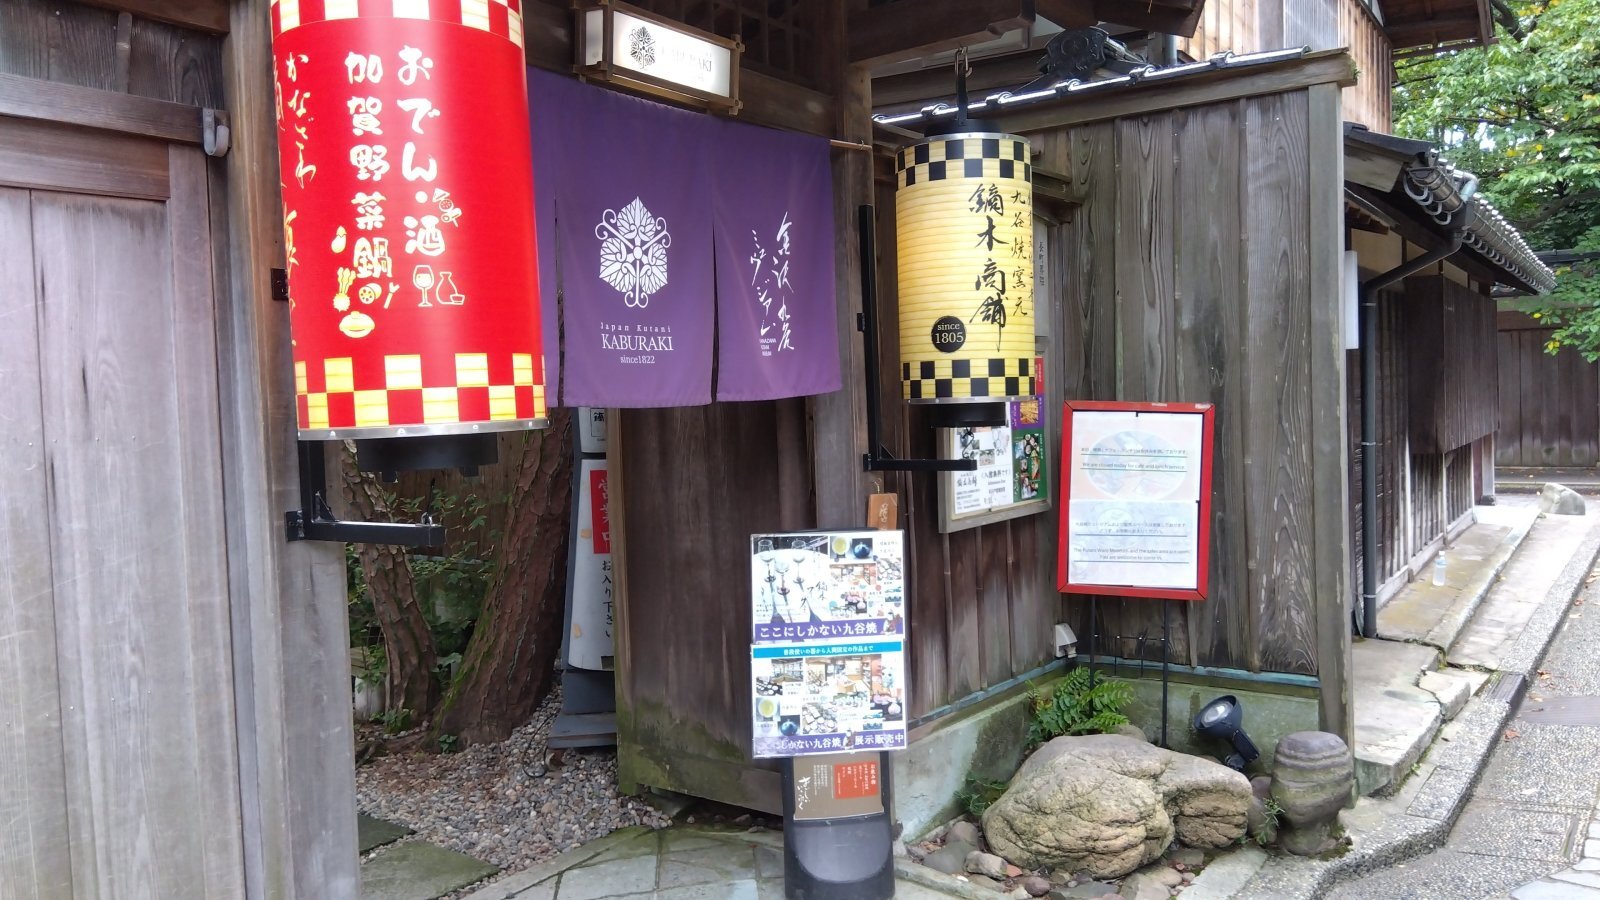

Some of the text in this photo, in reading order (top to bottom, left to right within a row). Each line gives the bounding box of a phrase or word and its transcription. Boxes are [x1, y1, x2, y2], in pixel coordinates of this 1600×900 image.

[396, 44, 446, 256] おでん・酒
[344, 51, 394, 278] 加賀野菜鍋
[600, 321, 672, 333] Japan Kutani
[937, 321, 961, 331] since
[601, 333, 675, 352] KABURAKI
[935, 332, 965, 345] 1805
[620, 355, 656, 364] since1822
[759, 621, 878, 638] ここにしかない九谷焼
